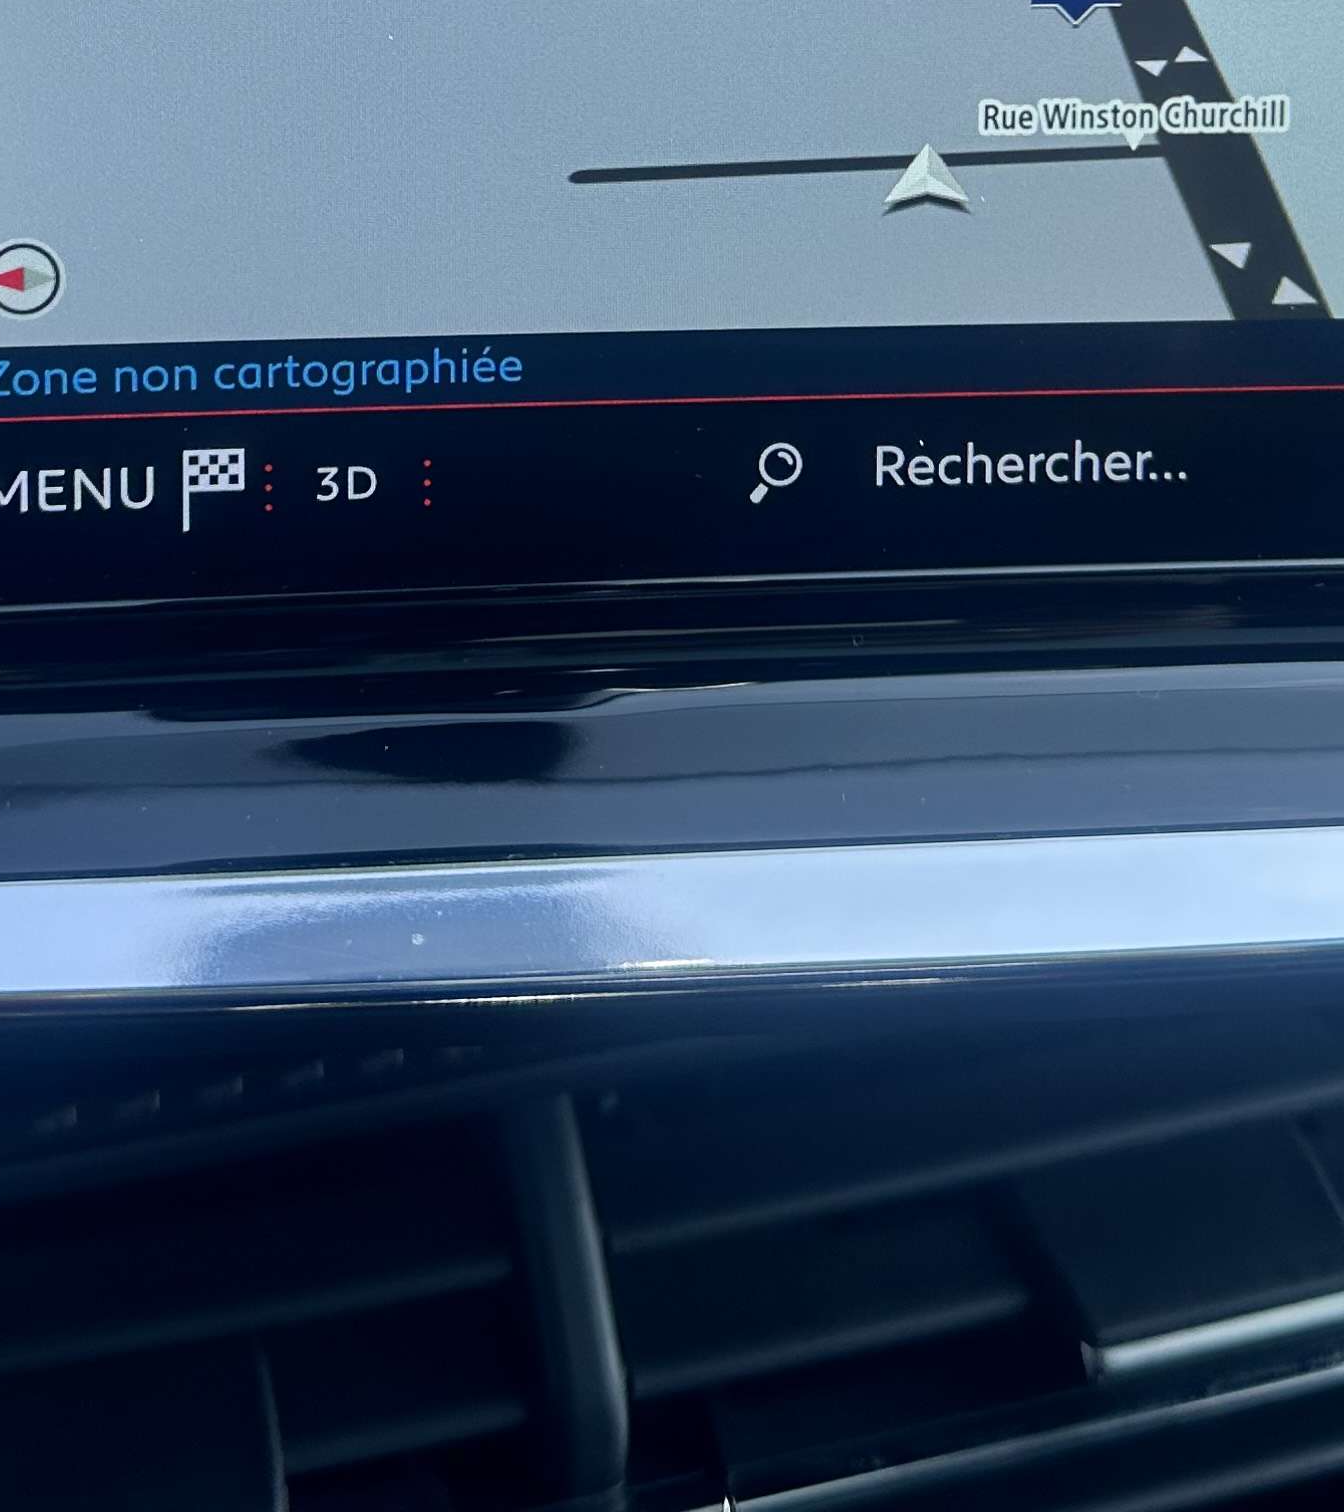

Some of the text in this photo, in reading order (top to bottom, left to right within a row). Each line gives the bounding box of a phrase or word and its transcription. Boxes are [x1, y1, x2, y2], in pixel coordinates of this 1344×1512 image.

[983, 100, 1286, 130] Rue Winston Churchill
[114, 365, 198, 394] non
[214, 347, 525, 396] cartographiée
[316, 465, 378, 503] 3D
[875, 439, 1189, 487] Rechercher...
